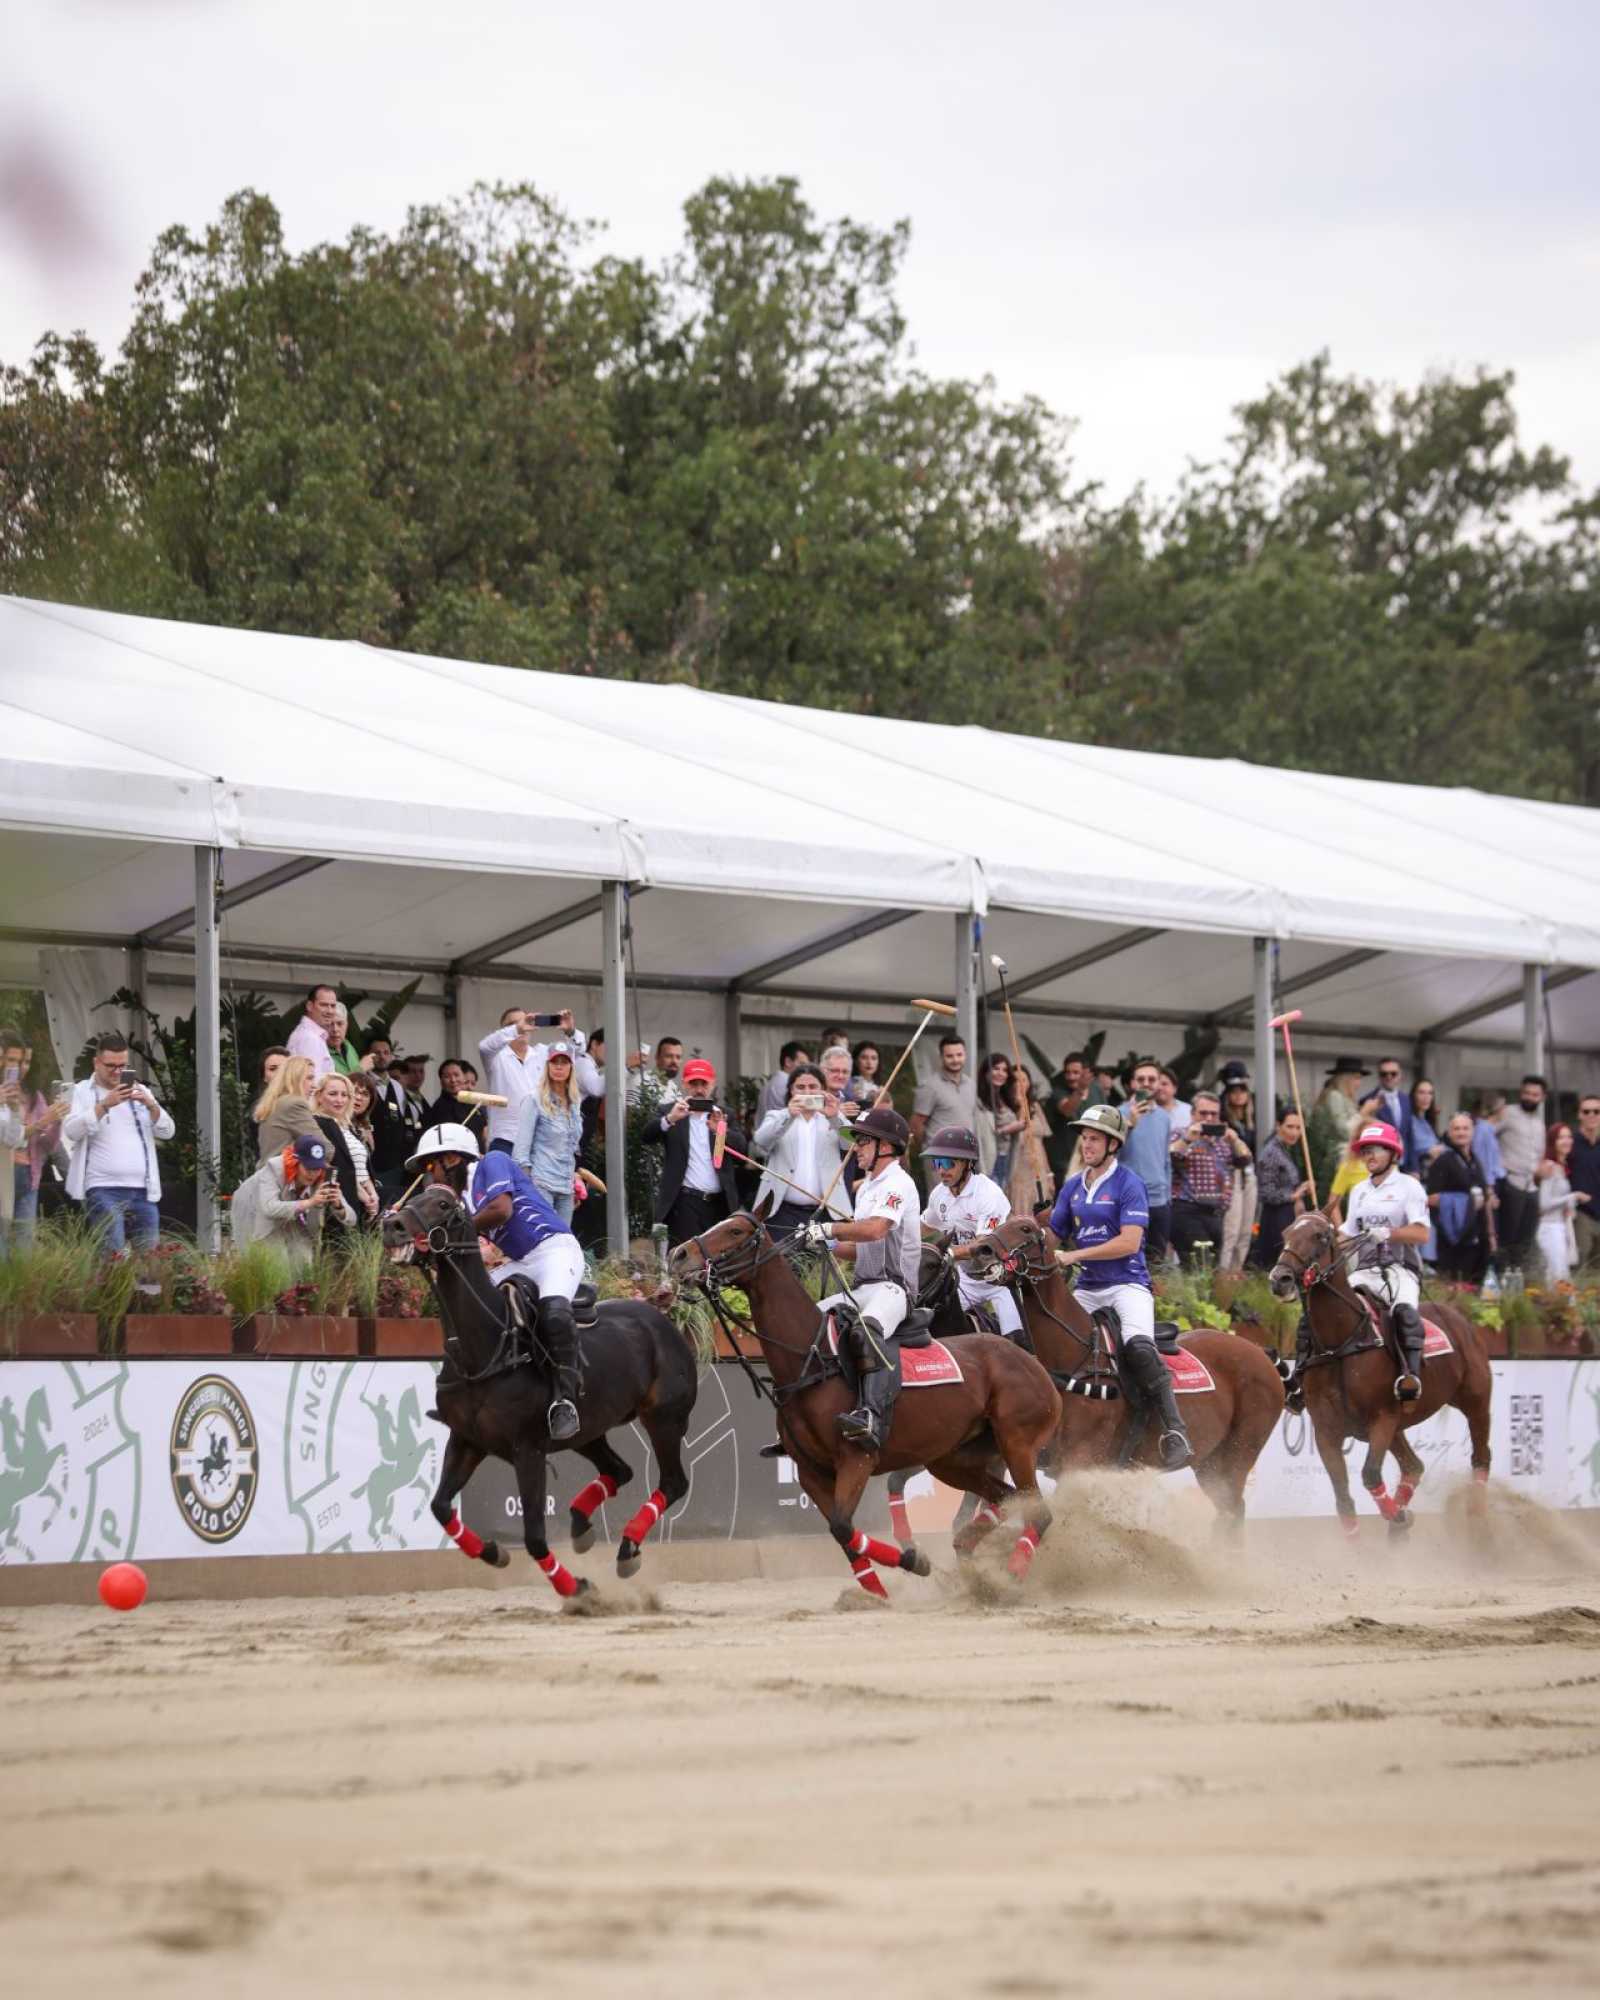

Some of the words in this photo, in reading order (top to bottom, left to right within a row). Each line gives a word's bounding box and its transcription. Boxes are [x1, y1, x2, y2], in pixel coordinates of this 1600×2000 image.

[83, 1414, 110, 1442] 2024
[223, 1391, 249, 1441] MANOR
[184, 1490, 219, 1531] POLO
[223, 1489, 245, 1527] CUP
[316, 1503, 341, 1529] ESTD
[505, 1495, 556, 1517] OSR
